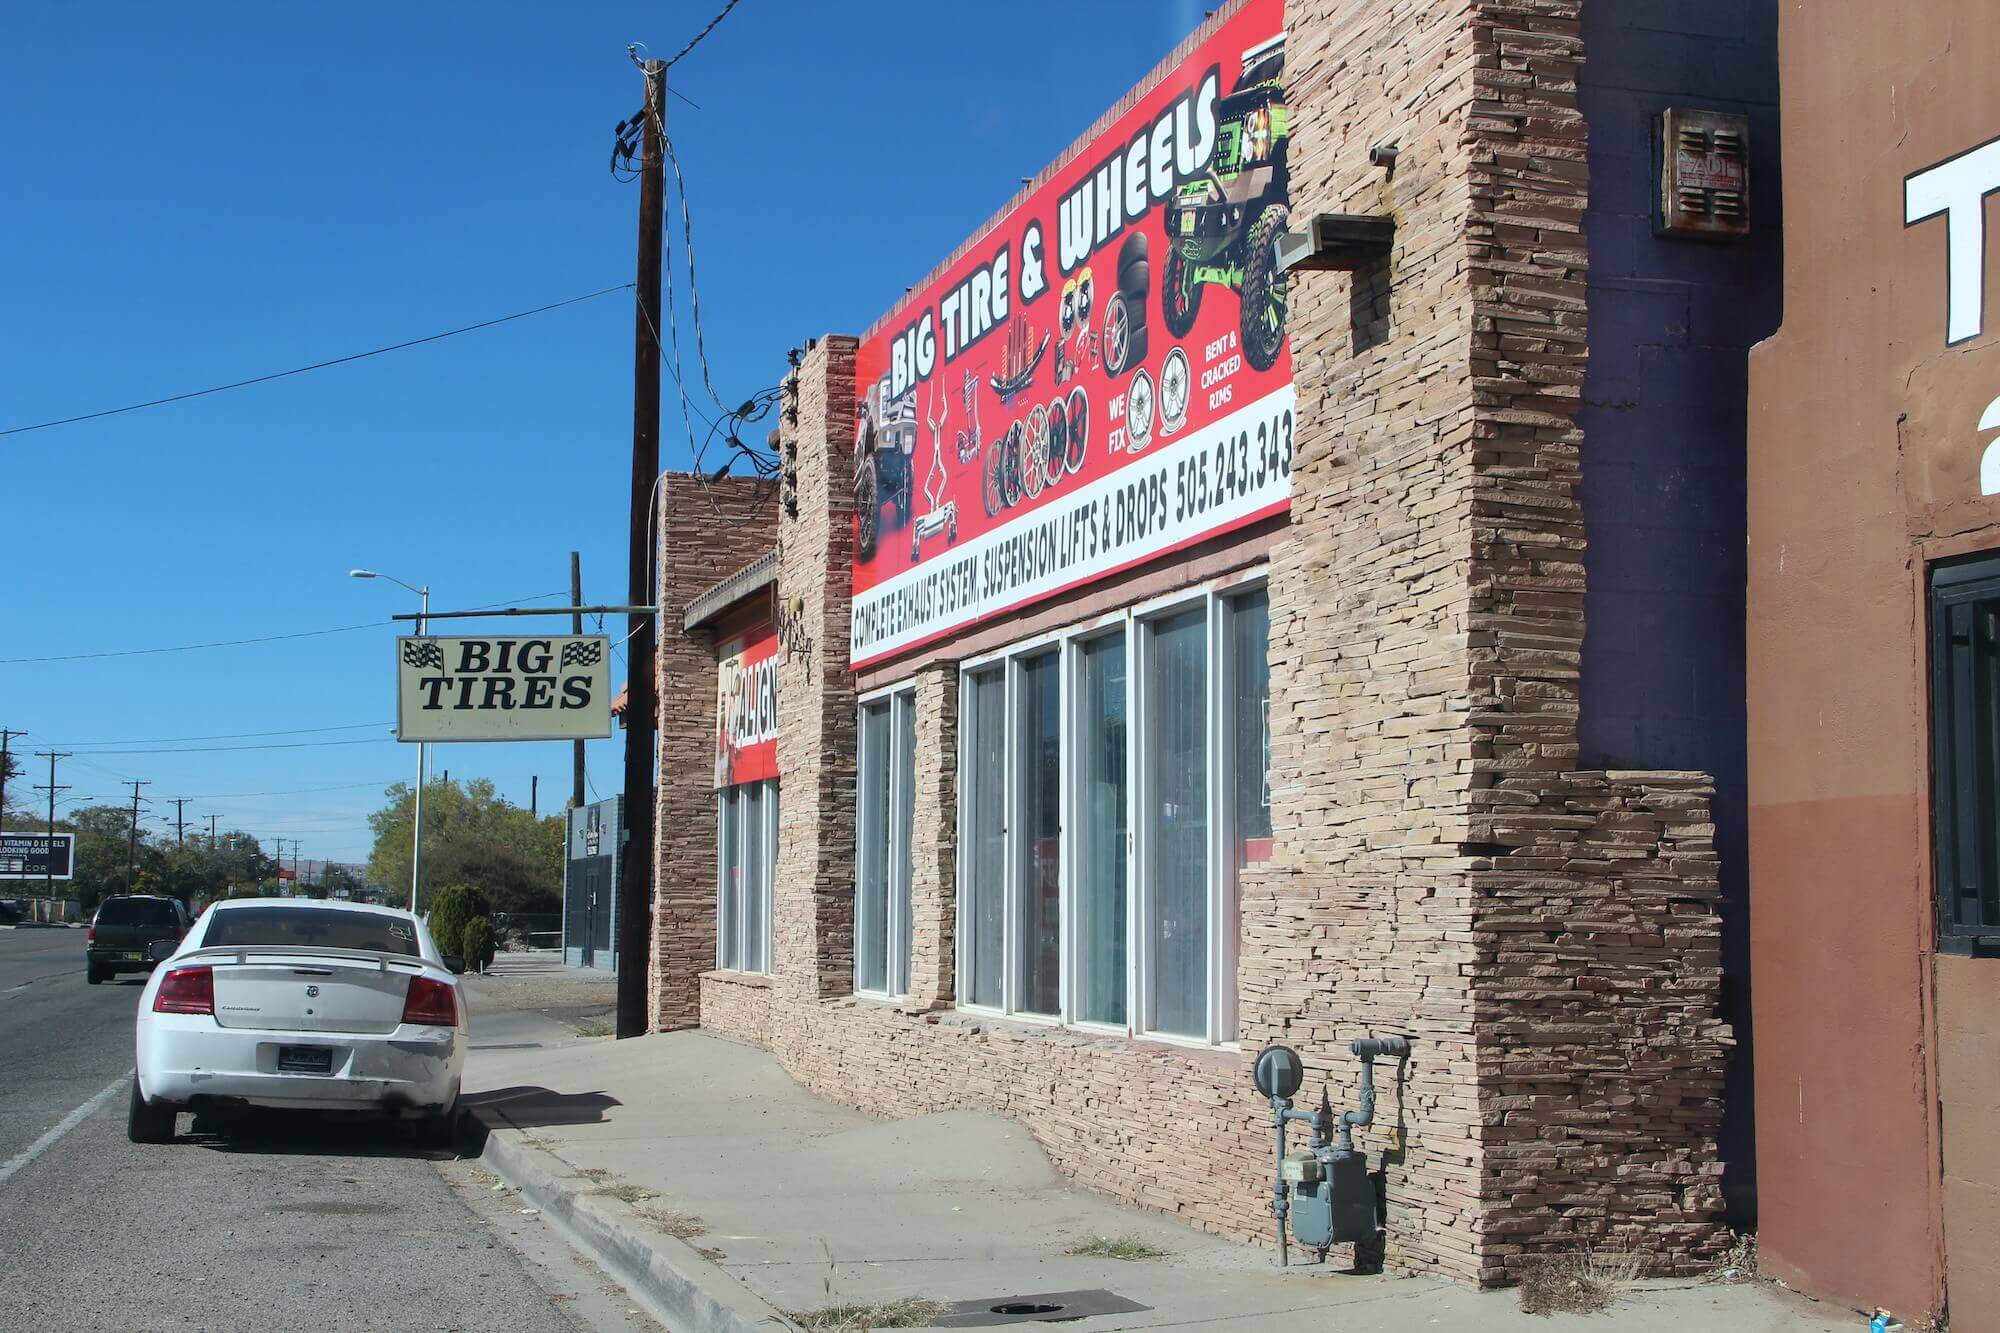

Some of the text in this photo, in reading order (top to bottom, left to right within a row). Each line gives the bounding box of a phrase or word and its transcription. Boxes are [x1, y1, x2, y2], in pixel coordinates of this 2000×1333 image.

[890, 66, 1219, 402] BIG TIRE & WHEELS
[1205, 330, 1237, 362] BENT &
[1201, 354, 1241, 389] CRACKED
[1109, 393, 1125, 421] WE
[1209, 384, 1232, 411] RIMS
[1108, 426, 1126, 455] FIX
[854, 592, 895, 650] COMPLETE
[897, 573, 938, 633] EXHAUST
[939, 555, 980, 616] SYSTEM,
[983, 519, 1057, 599] SUSPENSION
[1060, 499, 1098, 569] LIFTS
[1102, 494, 1111, 553] &
[1115, 467, 1168, 548] DROPS
[454, 640, 554, 674] BIG
[419, 675, 593, 711] TIRES
[30, 847, 50, 855] GOOD
[40, 840, 65, 848] LEELS
